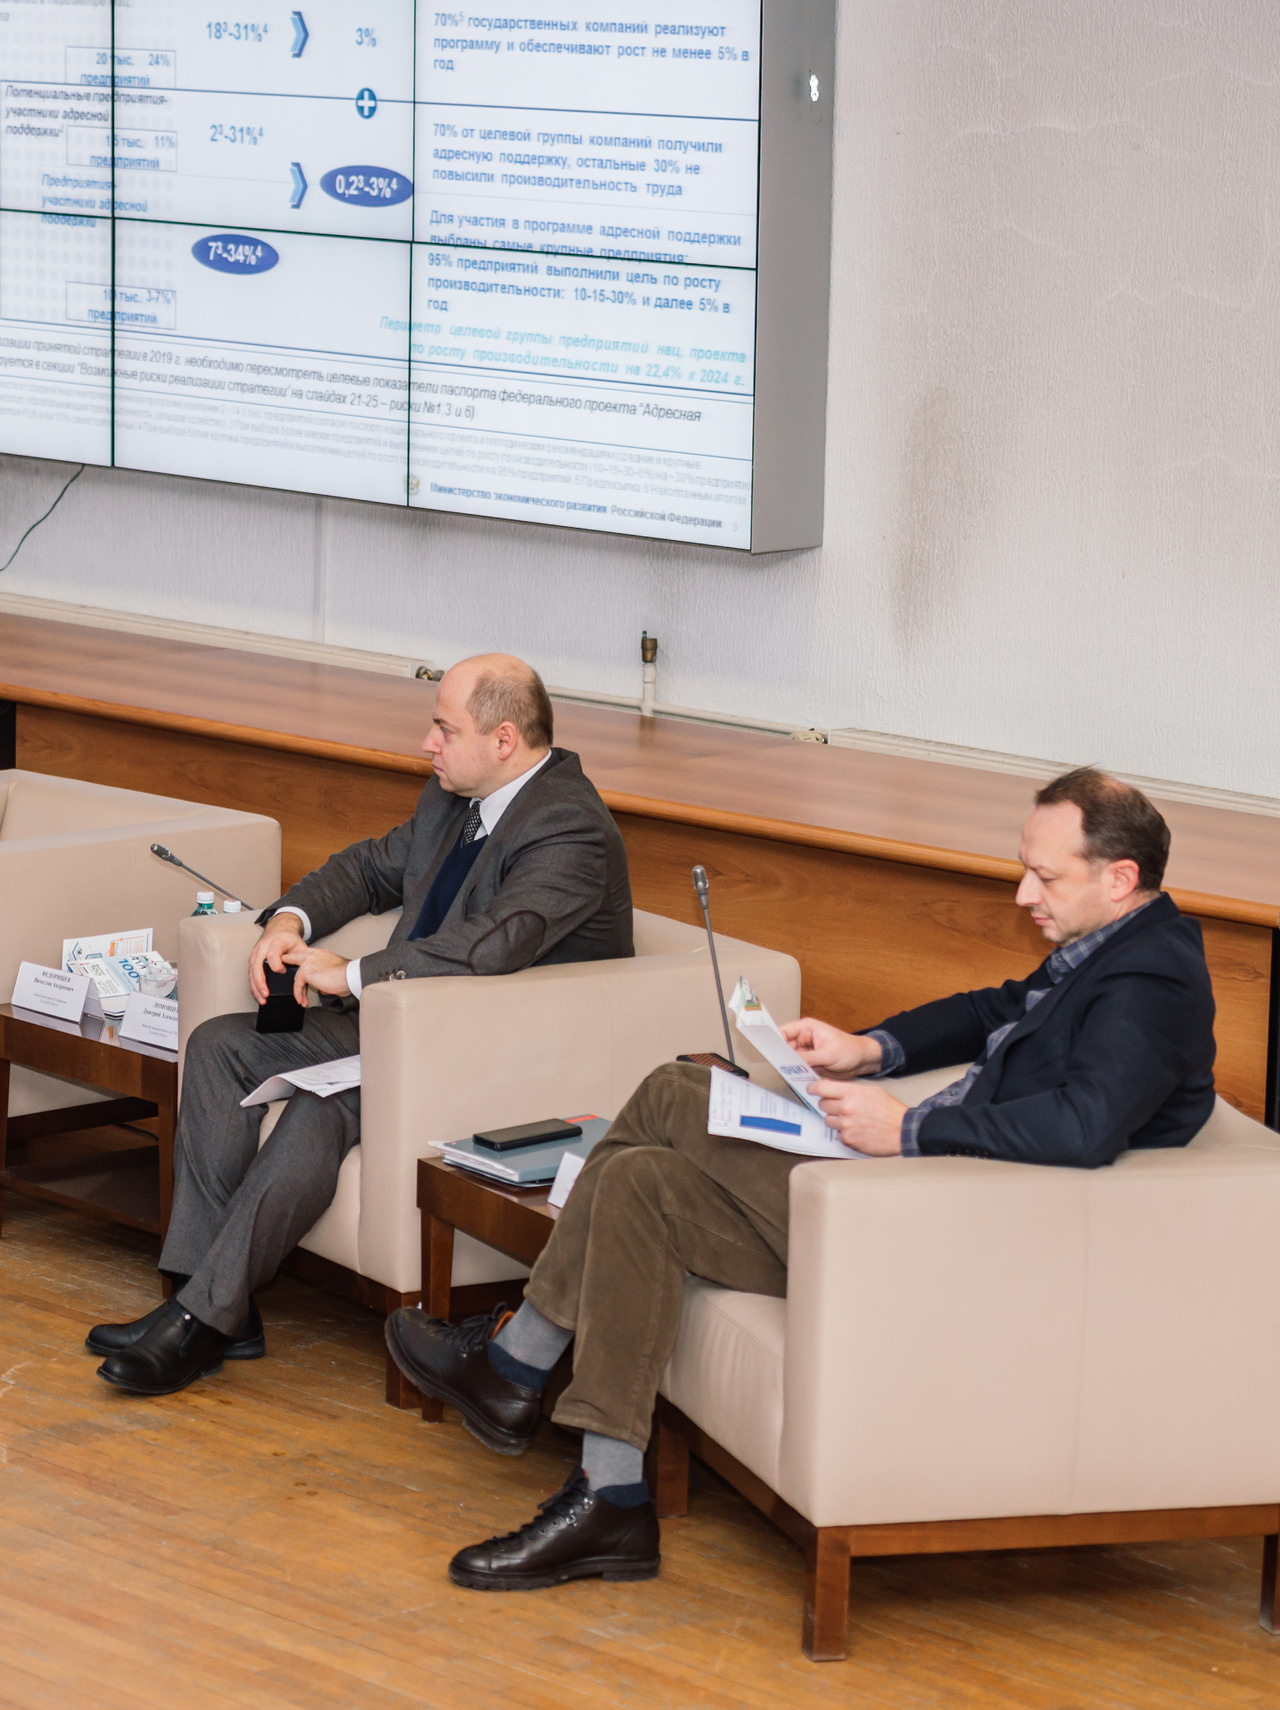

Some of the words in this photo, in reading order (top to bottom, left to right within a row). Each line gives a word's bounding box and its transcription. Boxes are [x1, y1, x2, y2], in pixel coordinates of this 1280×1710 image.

[355, 27, 377, 48] 3%
[468, 15, 578, 32] государственных
[585, 20, 648, 35] компаний
[654, 22, 727, 38] реализуют
[96, 52, 107, 65] 20
[148, 53, 170, 67] 24%
[433, 37, 500, 53] программу
[507, 41, 514, 52] и
[519, 38, 611, 58] обеспечивают
[617, 44, 646, 59] рост
[652, 46, 667, 58] не
[672, 47, 712, 60] менее
[718, 46, 738, 61] 5%
[741, 51, 749, 62] в
[433, 58, 455, 72] год
[5, 85, 91, 102] Потенциальные
[5, 106, 59, 120] участники
[62, 108, 109, 122] адресной
[122, 138, 144, 148] тыс.
[155, 135, 175, 148] 11%
[433, 123, 458, 139] 70%
[462, 127, 475, 139] от
[479, 126, 531, 144] целевой
[537, 131, 583, 147] группы
[589, 133, 652, 149] компаний
[658, 139, 723, 154] получили
[433, 148, 493, 164] адресную
[576, 156, 646, 172] остальные
[653, 158, 680, 174] 30%
[685, 162, 701, 175] не
[433, 168, 494, 184] повысили
[501, 172, 638, 193] производительность
[646, 181, 683, 198] труда
[430, 210, 454, 226] Для
[458, 214, 506, 231] участия
[512, 218, 520, 230] в
[524, 217, 593, 237] программе
[599, 220, 660, 240] адресной
[667, 229, 741, 248] поддержки
[428, 252, 452, 269] 95%
[457, 255, 538, 276] предприятий
[546, 263, 620, 282] выполнили
[626, 269, 658, 288] цель
[663, 272, 679, 288] по
[683, 275, 722, 293] росту
[428, 276, 565, 300] производительности:
[573, 287, 636, 307] 10-15-30%
[642, 294, 650, 307] и
[654, 294, 693, 311] далее
[699, 297, 719, 312] 5%
[722, 301, 730, 314] в
[428, 297, 448, 313] год
[449, 322, 501, 340] целевой
[505, 328, 553, 346] группы
[558, 333, 649, 355] предприятий
[657, 343, 684, 359] нац.
[689, 346, 746, 364] проекта
[32, 338, 81, 356] принятой
[150, 350, 172, 365] 2019
[185, 355, 244, 374] необходимо
[245, 362, 324, 383] пересмотреть
[326, 372, 370, 387] целевые
[373, 375, 439, 396] показатели
[440, 381, 497, 402] паспорта
[498, 388, 582, 410] федерального
[584, 399, 636, 416] проекта
[428, 342, 467, 361] росту
[473, 346, 619, 374] производительности
[625, 364, 641, 377] на
[688, 369, 696, 381] к
[700, 368, 731, 385] 2024
[734, 374, 746, 387] г.
[42, 360, 75, 374] секции
[140, 371, 167, 386] риски
[169, 374, 225, 391] реализации
[292, 389, 304, 400] на
[306, 390, 347, 405] слайдах
[350, 392, 378, 408] 21-25
[455, 408, 462, 418] и
[430, 482, 491, 500] Министерство
[493, 489, 564, 510] экономического
[566, 501, 607, 514] развития
[611, 504, 666, 523] Российской
[667, 508, 722, 529] Федерации
